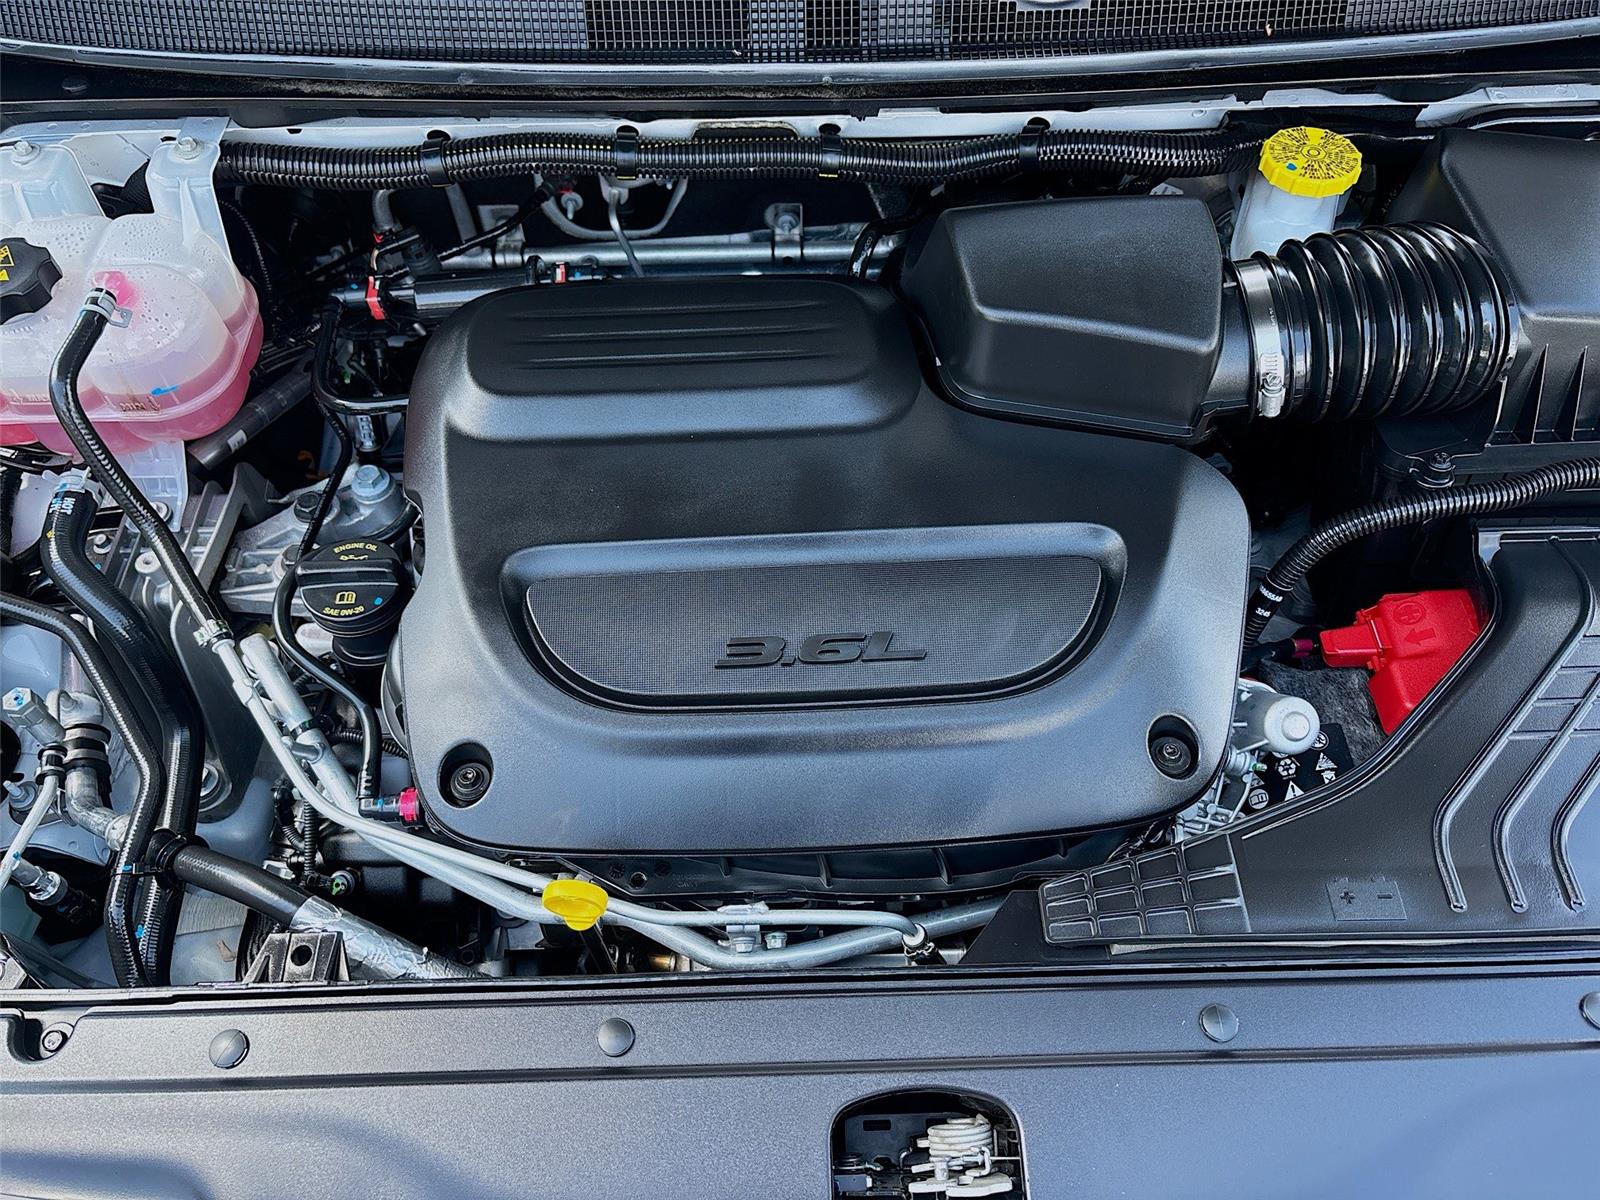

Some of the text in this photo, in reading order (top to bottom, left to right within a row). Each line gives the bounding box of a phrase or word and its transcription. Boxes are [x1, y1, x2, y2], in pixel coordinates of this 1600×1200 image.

[60, 497, 75, 514] HOT
[334, 542, 377, 553] ENGINE OIL
[323, 606, 364, 615] SAE 0W-20
[714, 630, 928, 669] 3.6L
